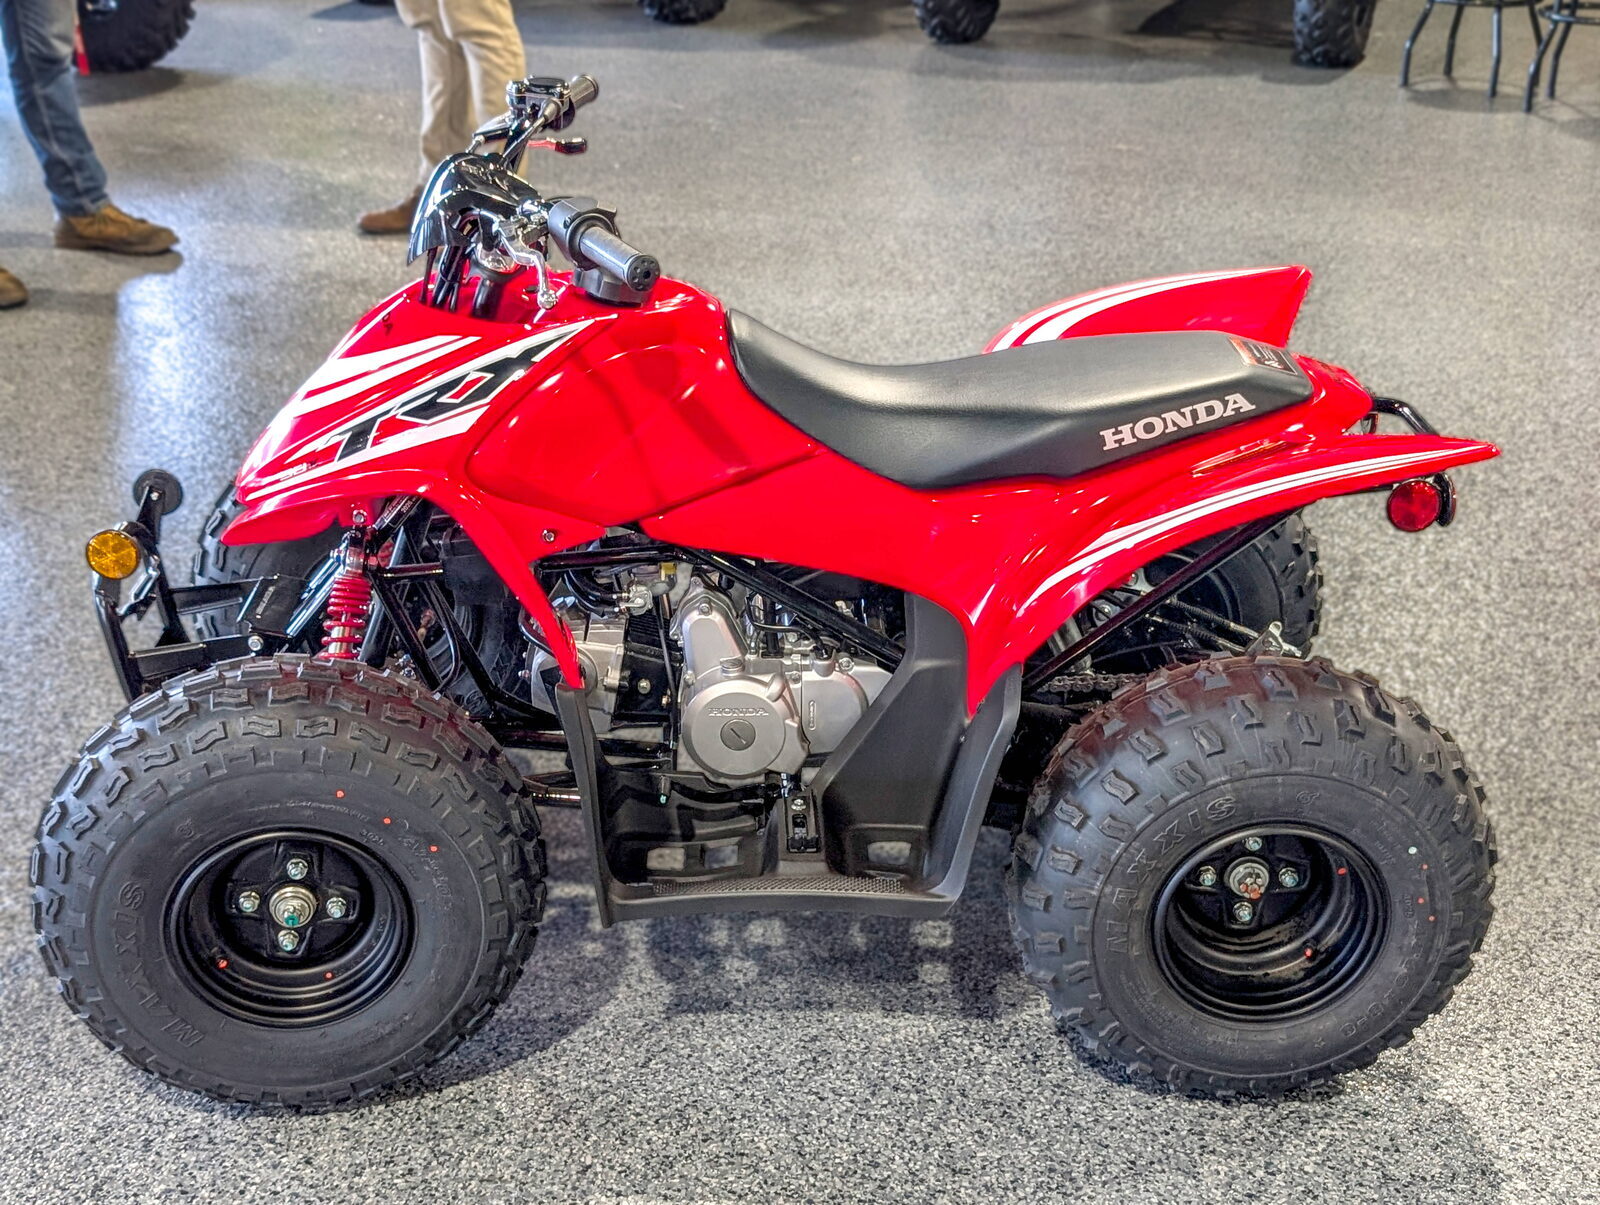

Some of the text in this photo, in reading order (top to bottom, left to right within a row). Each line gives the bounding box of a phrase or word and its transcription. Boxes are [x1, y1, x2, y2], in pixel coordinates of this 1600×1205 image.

[325, 319, 594, 463] TRX
[1099, 392, 1256, 451] HONDA
[708, 707, 769, 717] HONDA
[1105, 795, 1238, 955] MAXXIS
[114, 879, 206, 1049] MAXXIS
